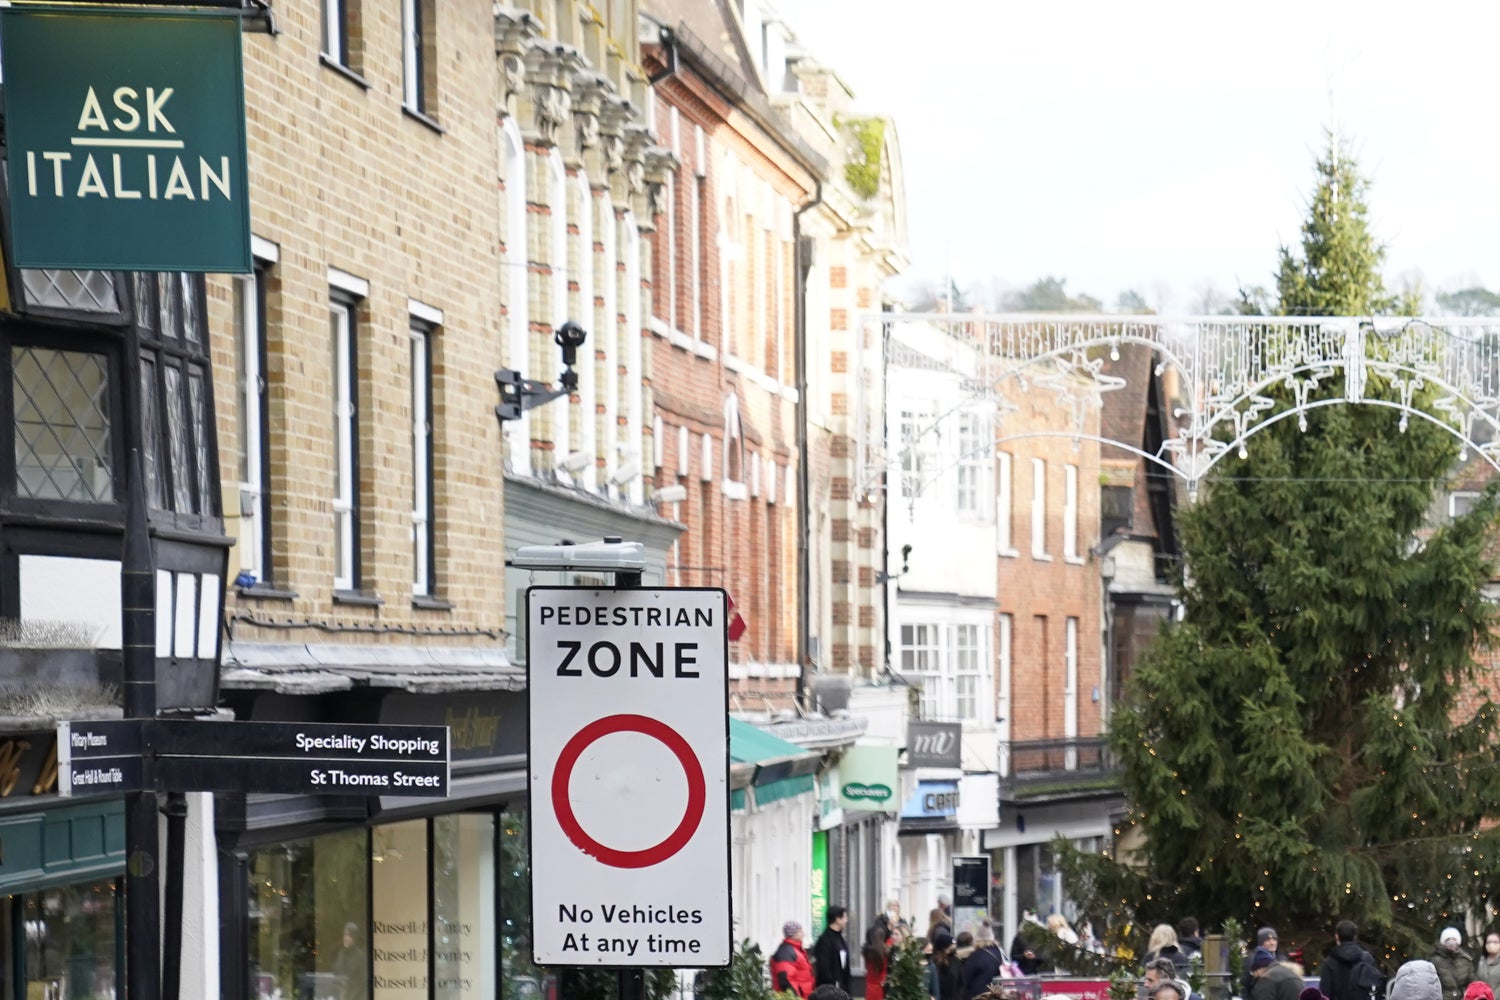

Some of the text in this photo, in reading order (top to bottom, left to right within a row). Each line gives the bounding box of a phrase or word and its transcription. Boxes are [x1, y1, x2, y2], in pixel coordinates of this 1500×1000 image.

[78, 84, 176, 133] ASK
[27, 151, 231, 201] ITALIAN
[540, 606, 713, 627] PEDESTRIAN
[556, 640, 700, 679] ZONE
[71, 731, 107, 751] Military Museums
[295, 733, 439, 754] Speciality Shopping
[72, 770, 85, 785] Great
[84, 769, 94, 785] Hall
[98, 769, 111, 784] Round
[111, 768, 122, 783] Table
[310, 769, 440, 787] St Thomas Street
[846, 786, 889, 798] Specsavers
[559, 904, 703, 924] No Vehicles
[562, 933, 701, 956] At any time
